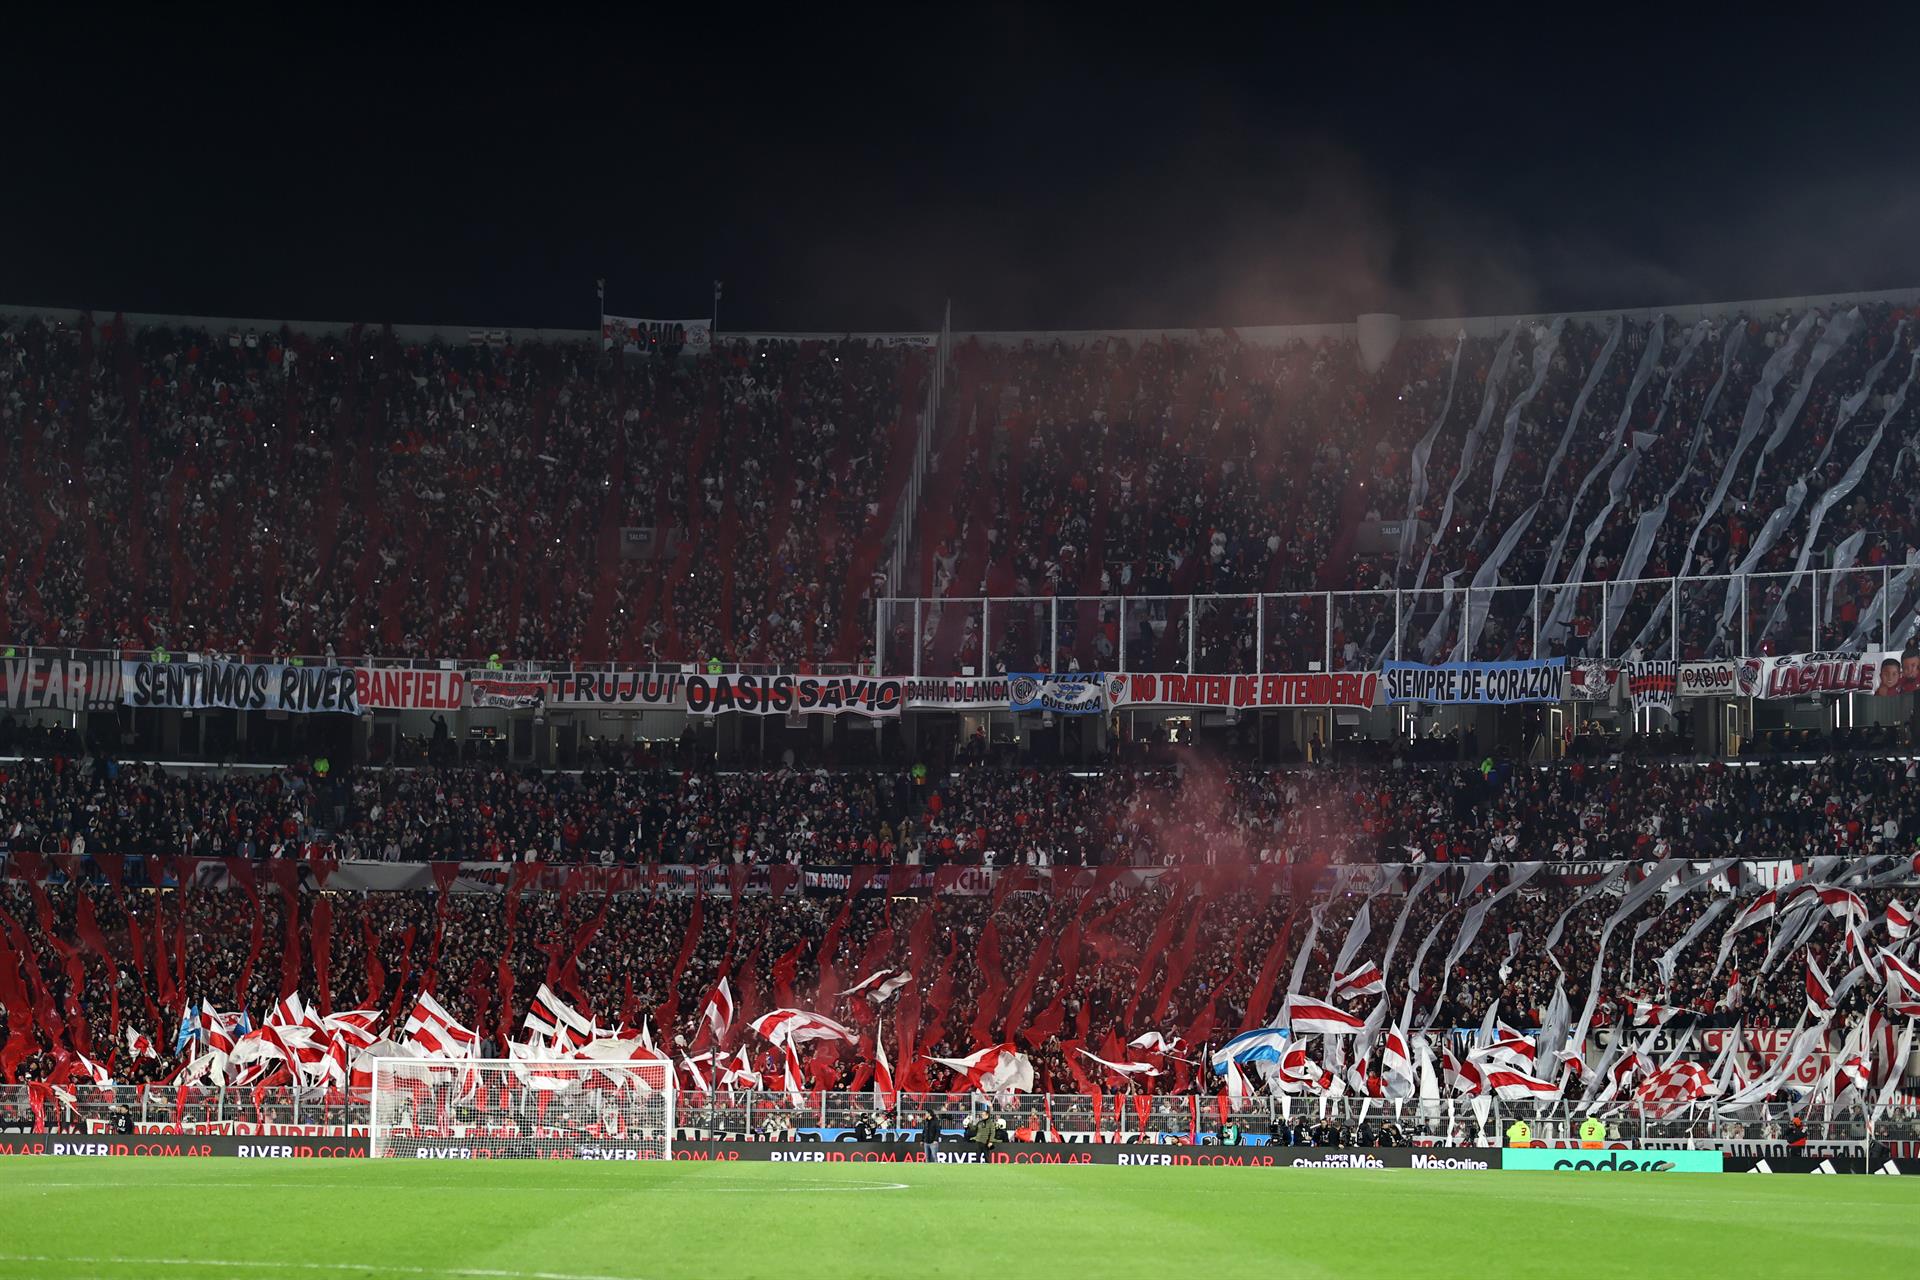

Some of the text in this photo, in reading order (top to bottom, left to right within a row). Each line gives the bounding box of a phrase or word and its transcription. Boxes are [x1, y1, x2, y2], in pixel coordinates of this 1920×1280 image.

[134, 664, 357, 712] SENTIMOS RIVER
[358, 669, 463, 709] BANFIELD
[1131, 673, 1377, 709] NO TRATEN DE ENTENDERLO
[1387, 669, 1456, 700] SIEMPRE
[1461, 671, 1481, 700] DE
[1486, 661, 1563, 700] CORAZÓN
[1627, 661, 1677, 688] BARRIO
[1684, 666, 1730, 688] PABLO
[1770, 663, 1875, 697] LASALLE
[687, 675, 792, 713] OASIS
[800, 678, 901, 711] SAVIO
[908, 681, 1010, 702] BAHIA BLANCA
[1041, 693, 1101, 711] GUERNICA
[805, 872, 818, 887] UN
[820, 873, 844, 888] POCO
[1702, 1029, 1829, 1051] CERVEA
